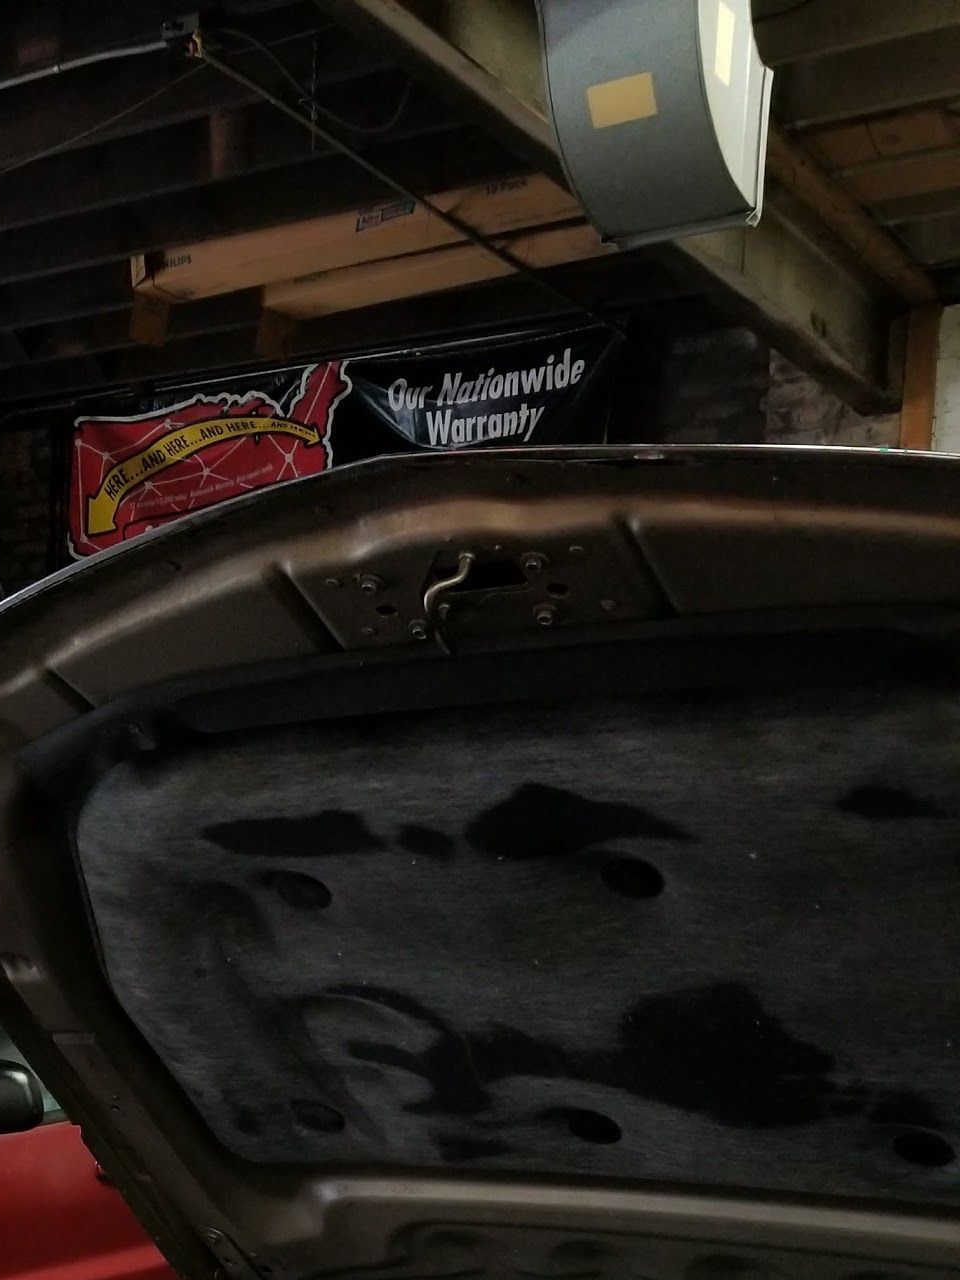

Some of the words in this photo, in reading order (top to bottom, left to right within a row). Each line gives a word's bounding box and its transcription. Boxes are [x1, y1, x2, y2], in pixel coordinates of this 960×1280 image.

[388, 377, 433, 411] Our
[436, 347, 586, 406] Nationwide
[425, 402, 546, 445] Warranty
